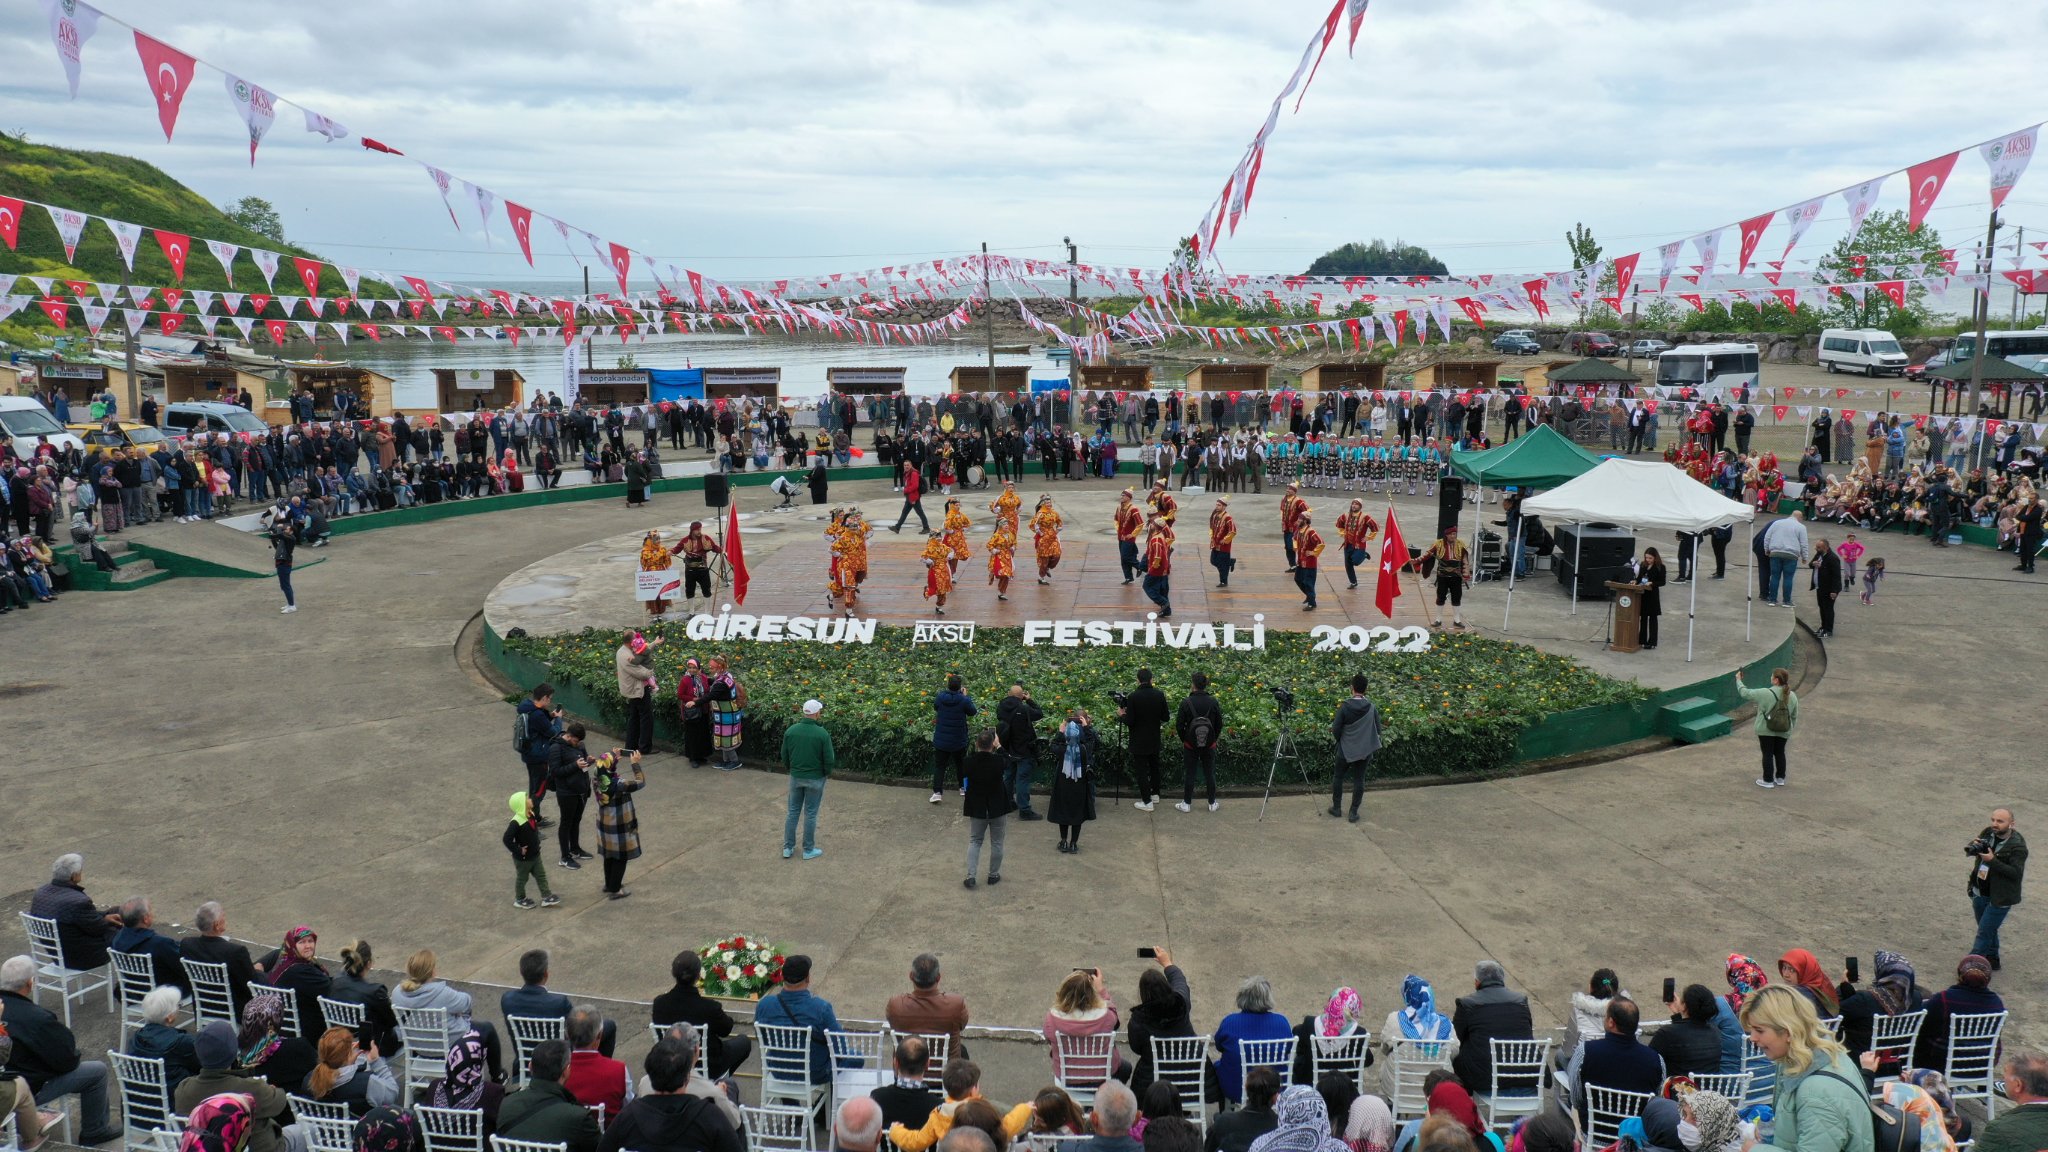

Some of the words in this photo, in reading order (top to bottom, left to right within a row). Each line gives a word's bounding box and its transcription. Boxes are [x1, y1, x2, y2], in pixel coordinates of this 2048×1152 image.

[2005, 136, 2031, 154] AKSU
[590, 374, 646, 384] toprakanadan
[686, 603, 877, 645] GİRESUN
[915, 622, 974, 645] AKSU
[1023, 612, 1265, 651] FESTİVALİ
[1310, 625, 1432, 653] 2022
